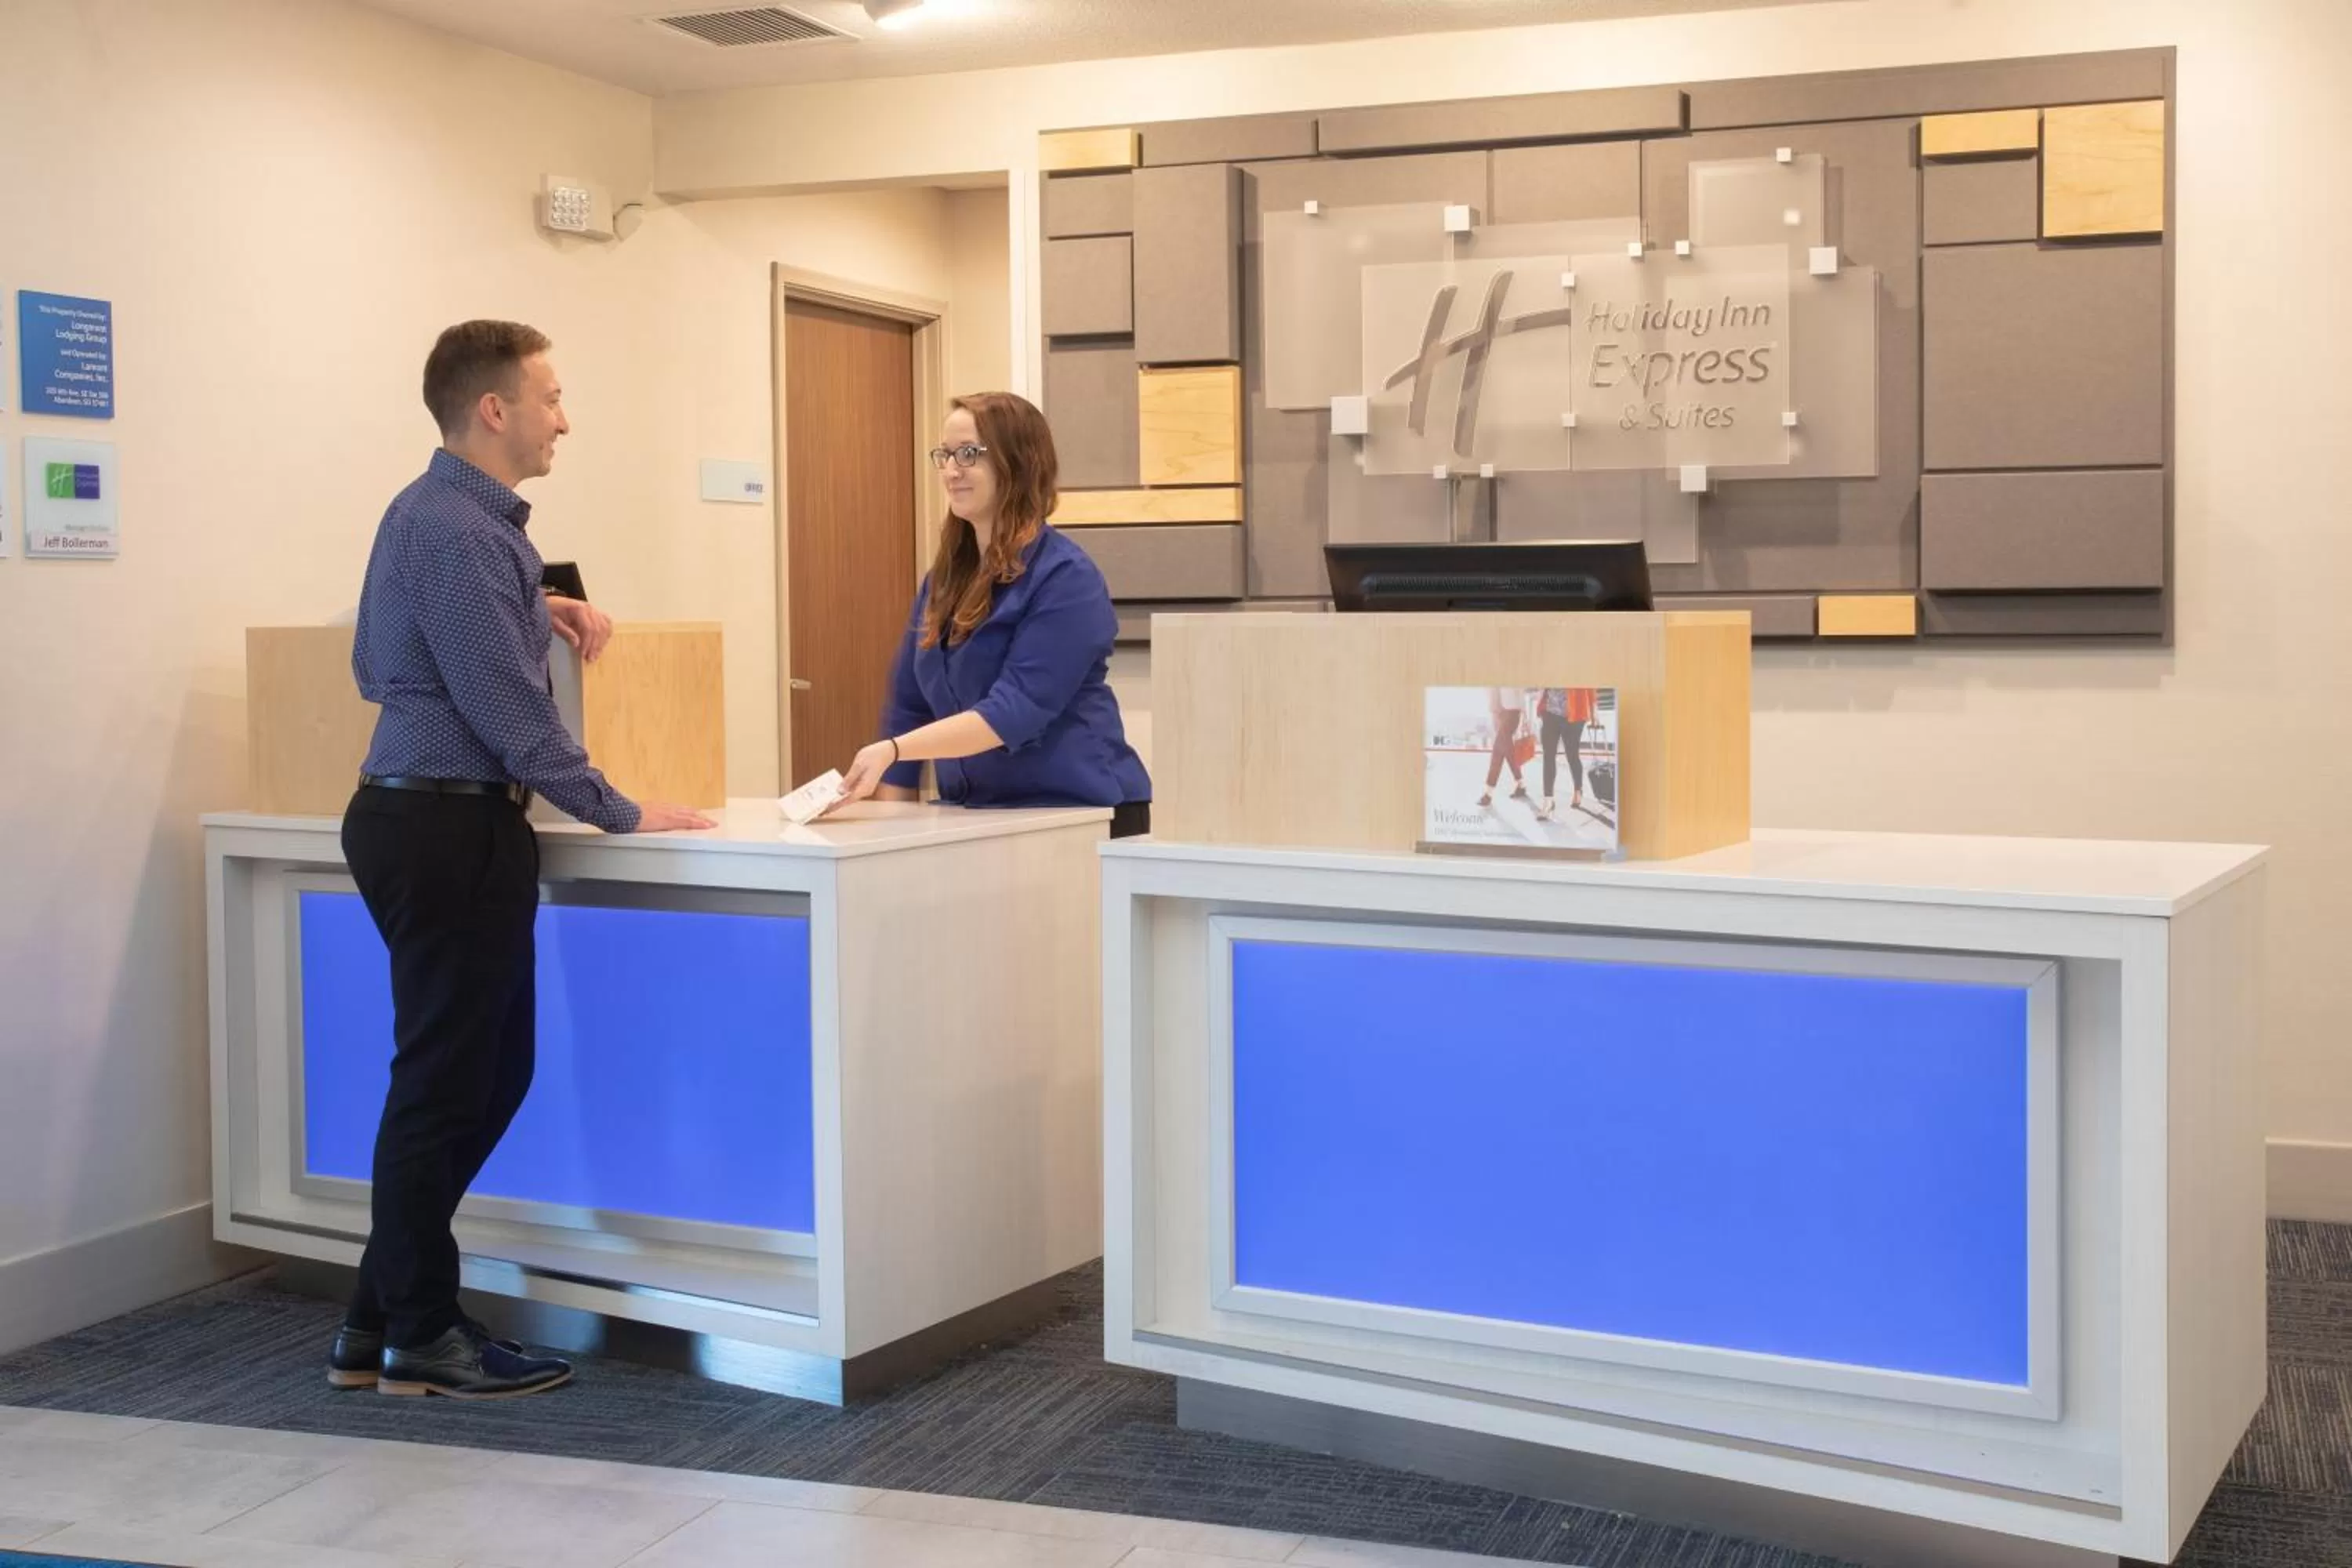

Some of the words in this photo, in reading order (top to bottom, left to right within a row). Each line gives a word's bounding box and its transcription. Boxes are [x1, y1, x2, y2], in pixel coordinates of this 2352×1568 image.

[1586, 299, 1713, 337] Holiday
[1721, 296, 1770, 327] Inn
[56, 329, 85, 343] Lodging
[85, 332, 107, 344] Group
[1588, 343, 1771, 398] Express
[1617, 404, 1640, 431] &
[1646, 401, 1736, 430] Suites
[44, 535, 60, 547] Jeff
